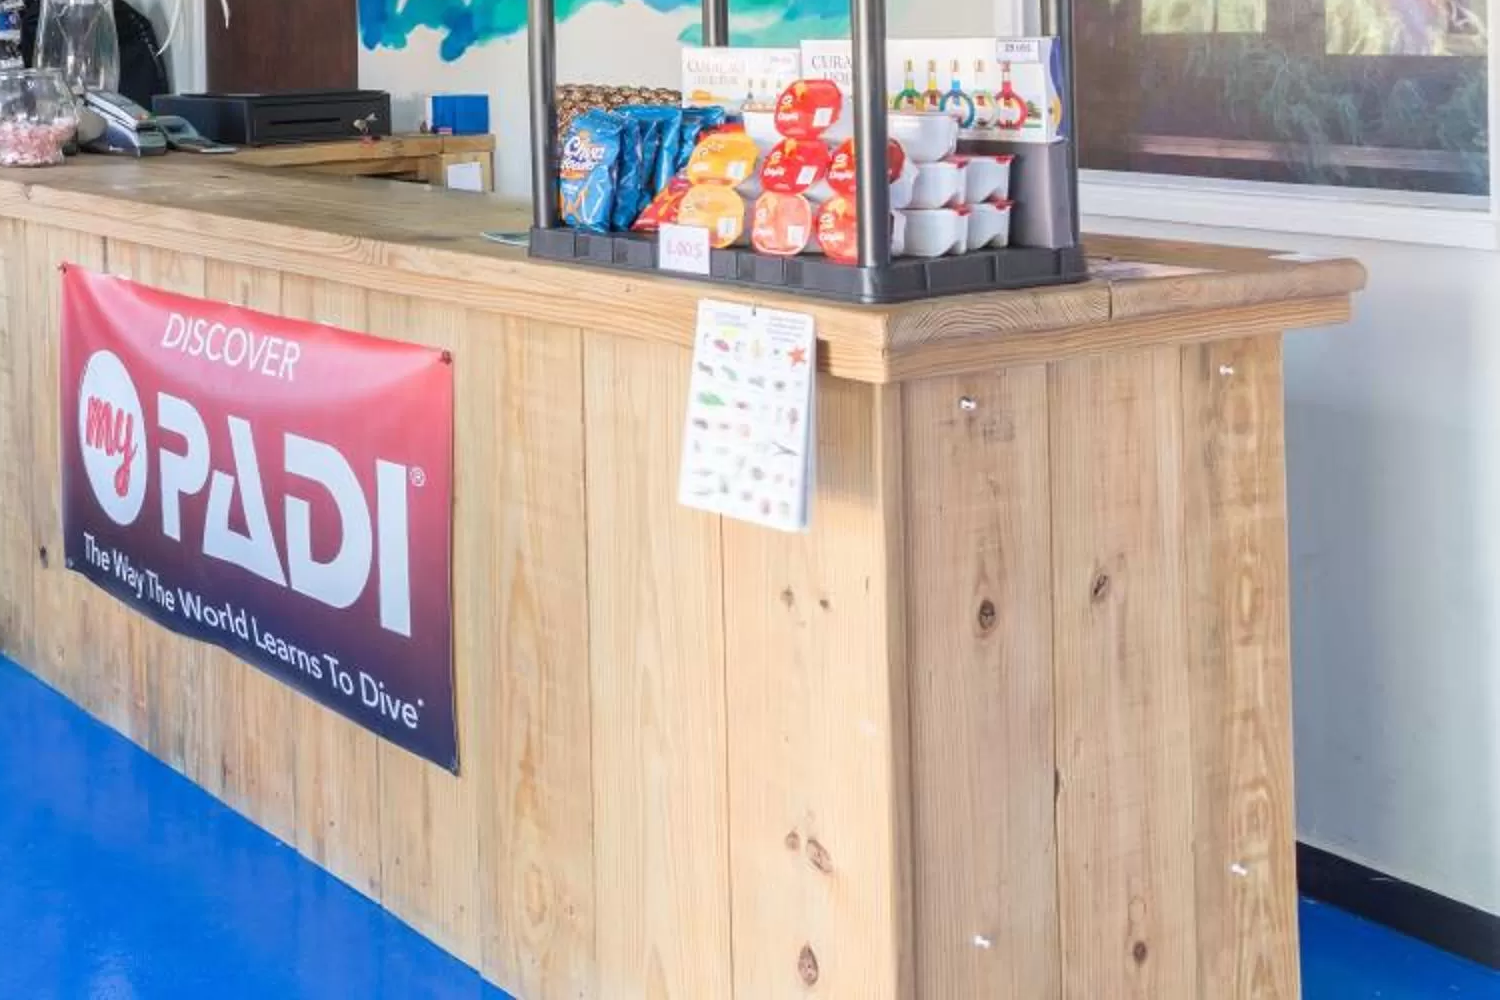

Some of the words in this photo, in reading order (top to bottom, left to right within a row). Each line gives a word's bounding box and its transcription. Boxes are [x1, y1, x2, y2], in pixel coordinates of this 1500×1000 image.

[811, 55, 852, 69] CURA
[161, 312, 300, 381] DISCOVER
[85, 395, 135, 496] my
[157, 391, 412, 638] PADI
[83, 531, 111, 571] The
[111, 549, 145, 599] Way
[145, 569, 175, 611] The
[177, 587, 249, 641] World
[251, 615, 323, 679] Learns
[323, 653, 354, 695] To
